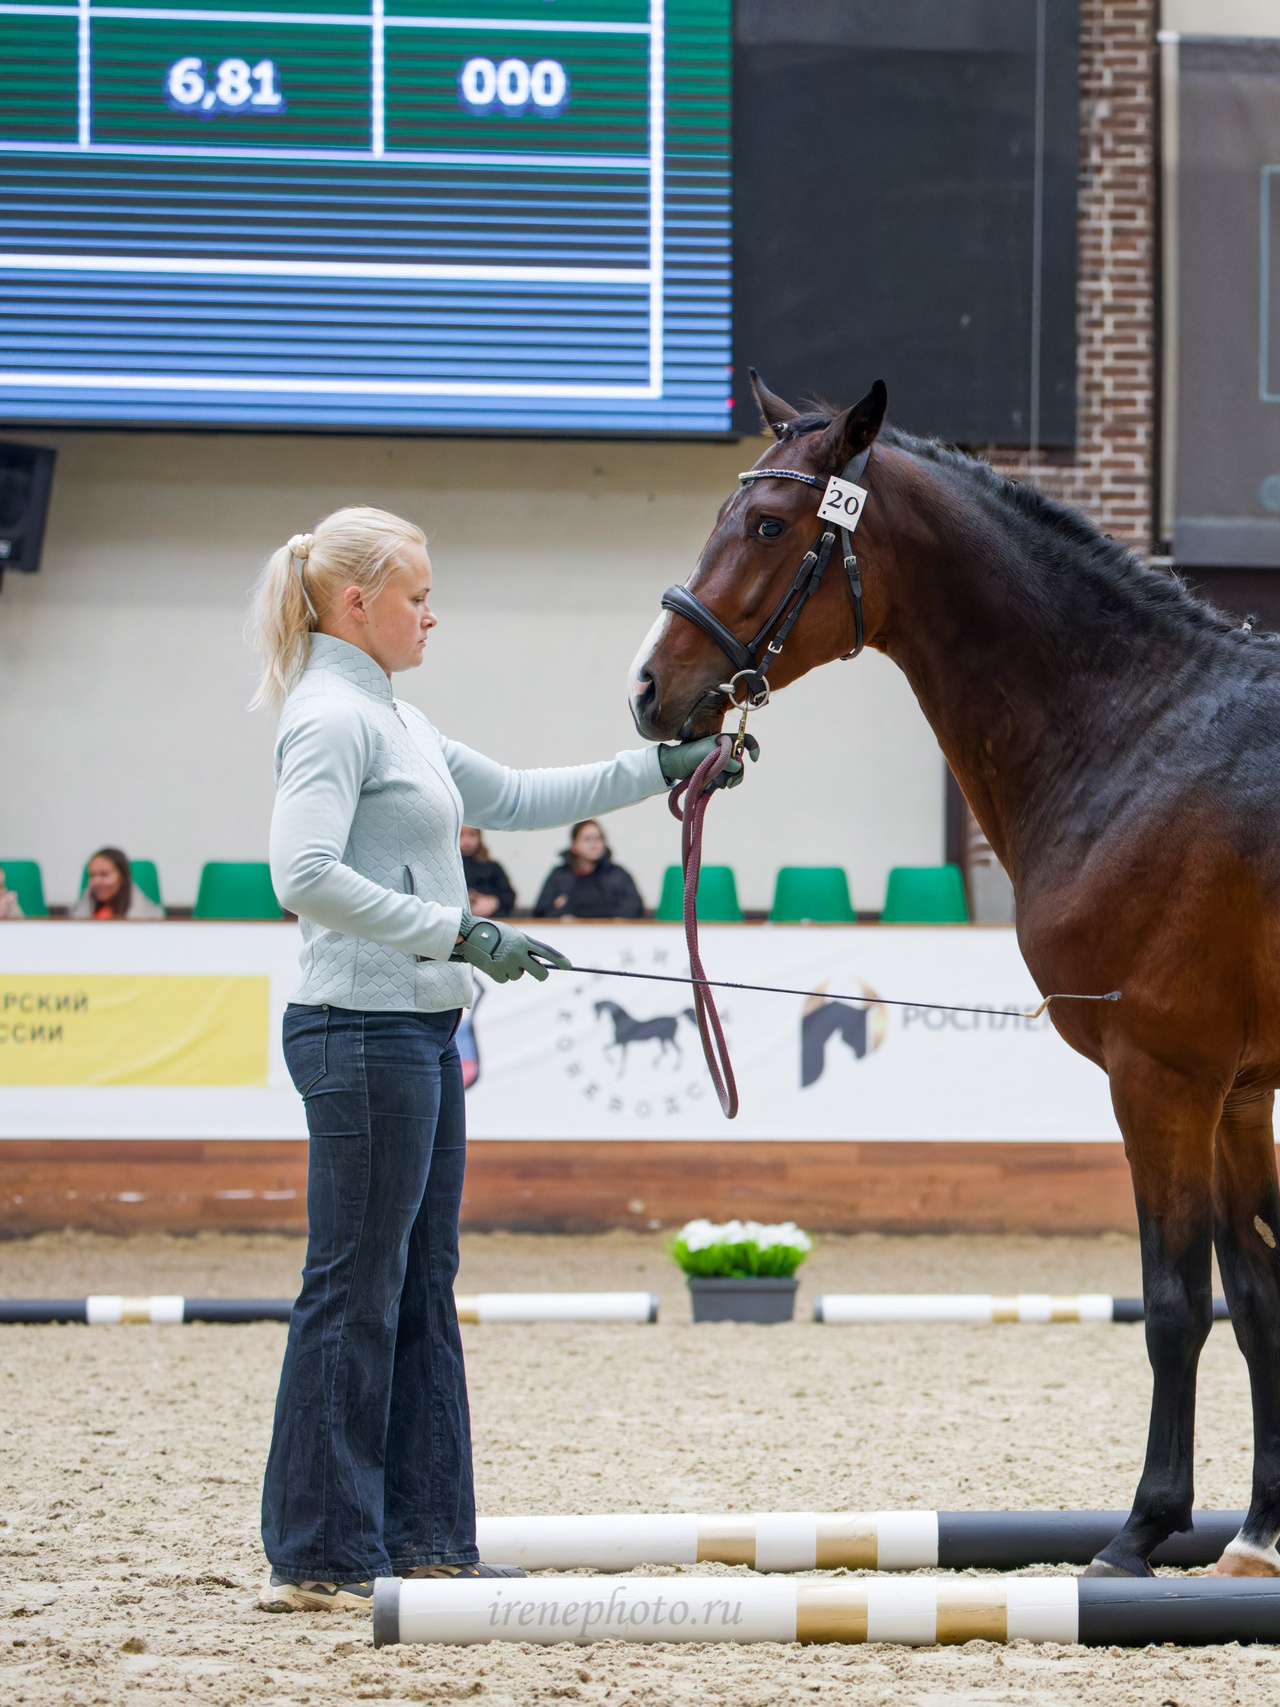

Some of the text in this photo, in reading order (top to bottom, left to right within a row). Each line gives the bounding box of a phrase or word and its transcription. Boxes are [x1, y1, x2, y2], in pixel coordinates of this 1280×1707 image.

[168, 56, 284, 113] 6,81
[460, 56, 567, 109] 000
[826, 489, 859, 516] 20
